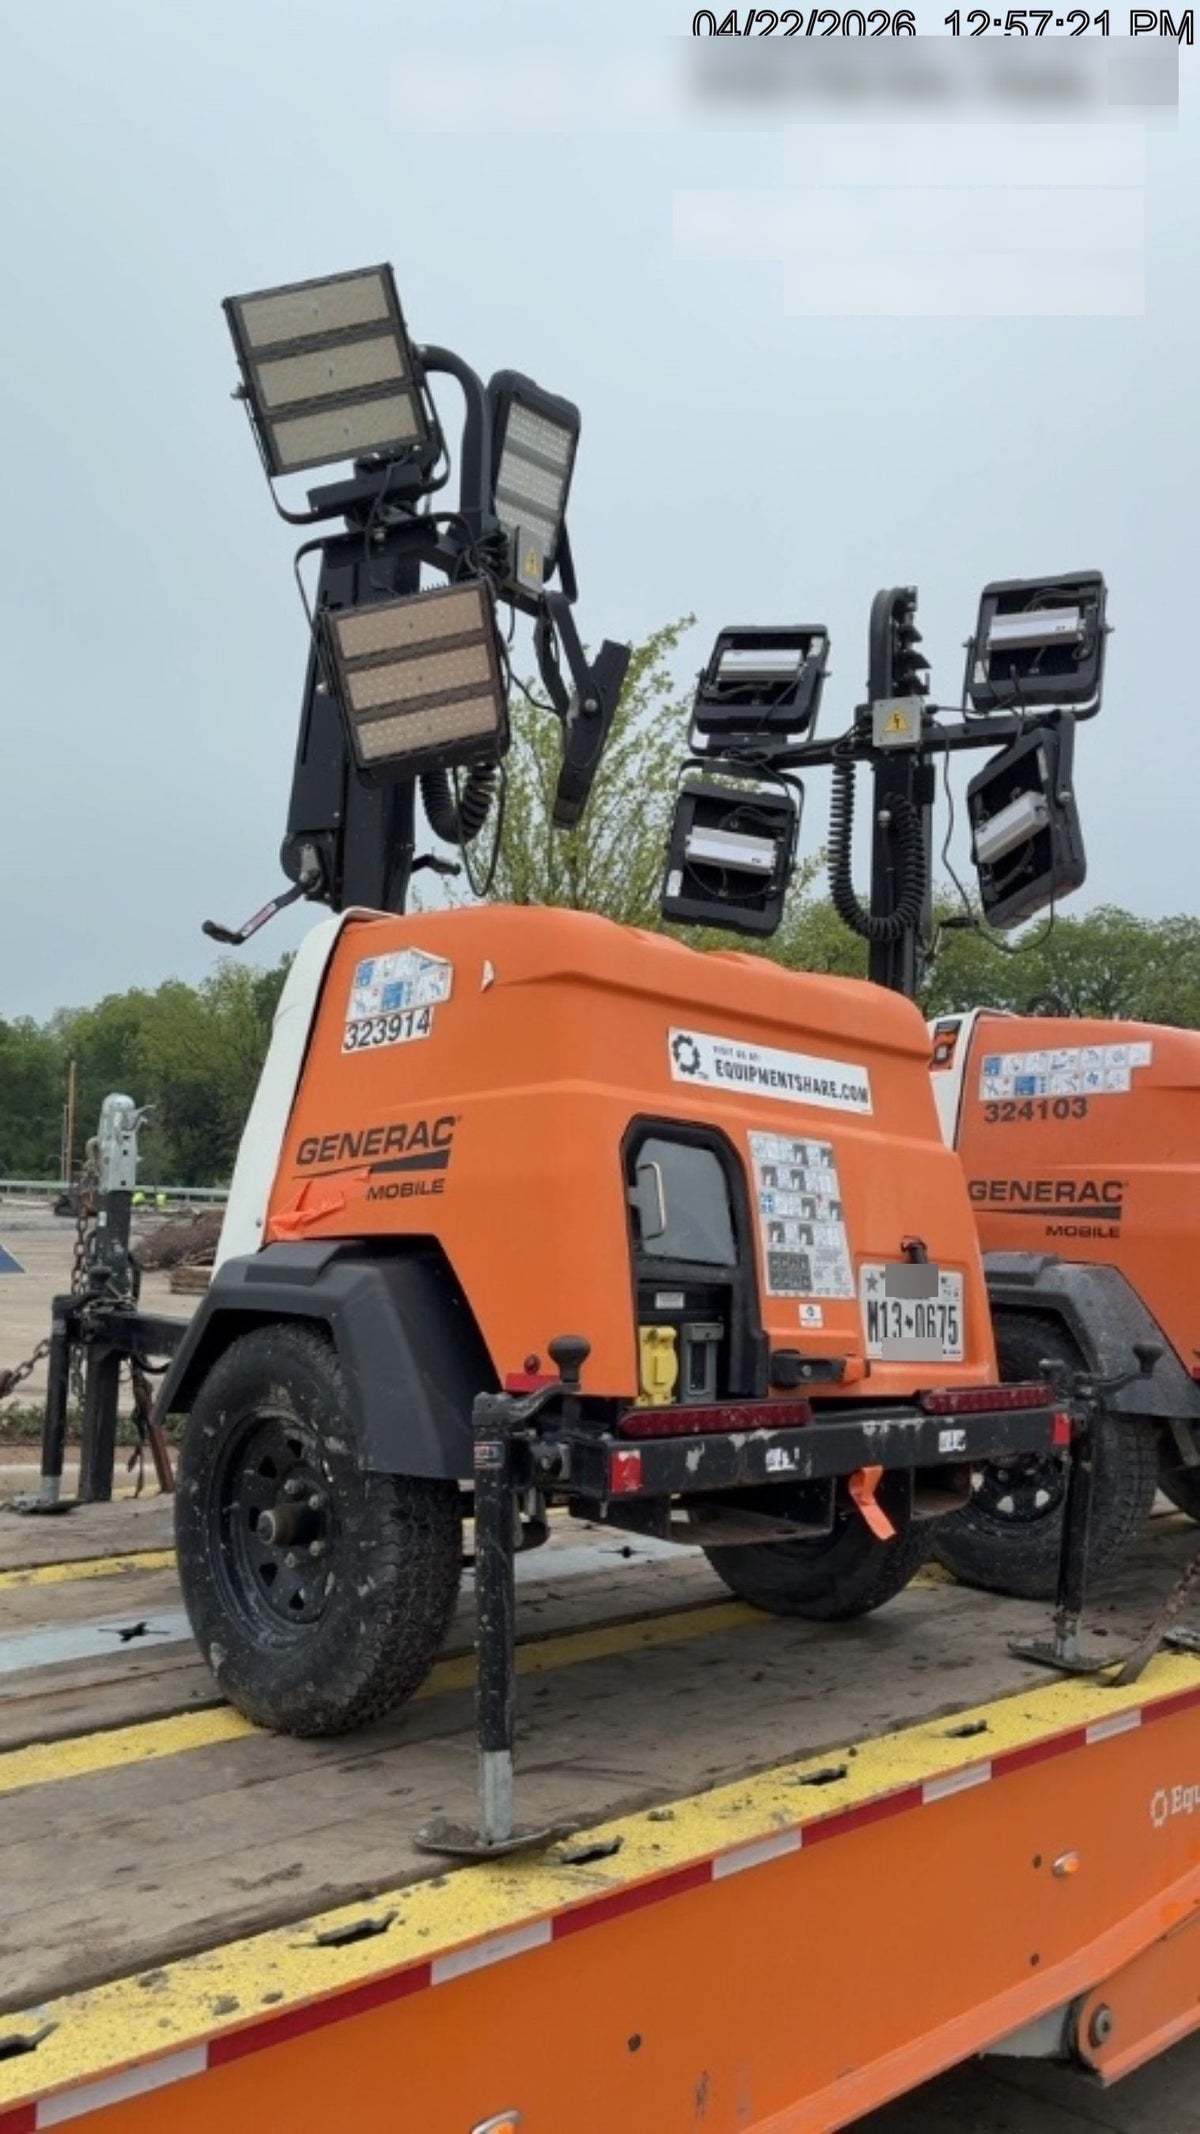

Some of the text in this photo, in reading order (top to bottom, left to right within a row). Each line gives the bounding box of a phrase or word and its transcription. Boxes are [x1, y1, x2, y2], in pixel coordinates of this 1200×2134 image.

[343, 1007, 431, 1050] 323914
[715, 1059, 869, 1103] EQUIPMENTSHARE.COM
[983, 1097, 1088, 1123] 324103
[296, 1116, 456, 1165] GENERAC
[366, 1178, 446, 1201] MOBILE
[968, 1180, 1123, 1203] GENERAC
[1045, 1225, 1121, 1239] MOBILE
